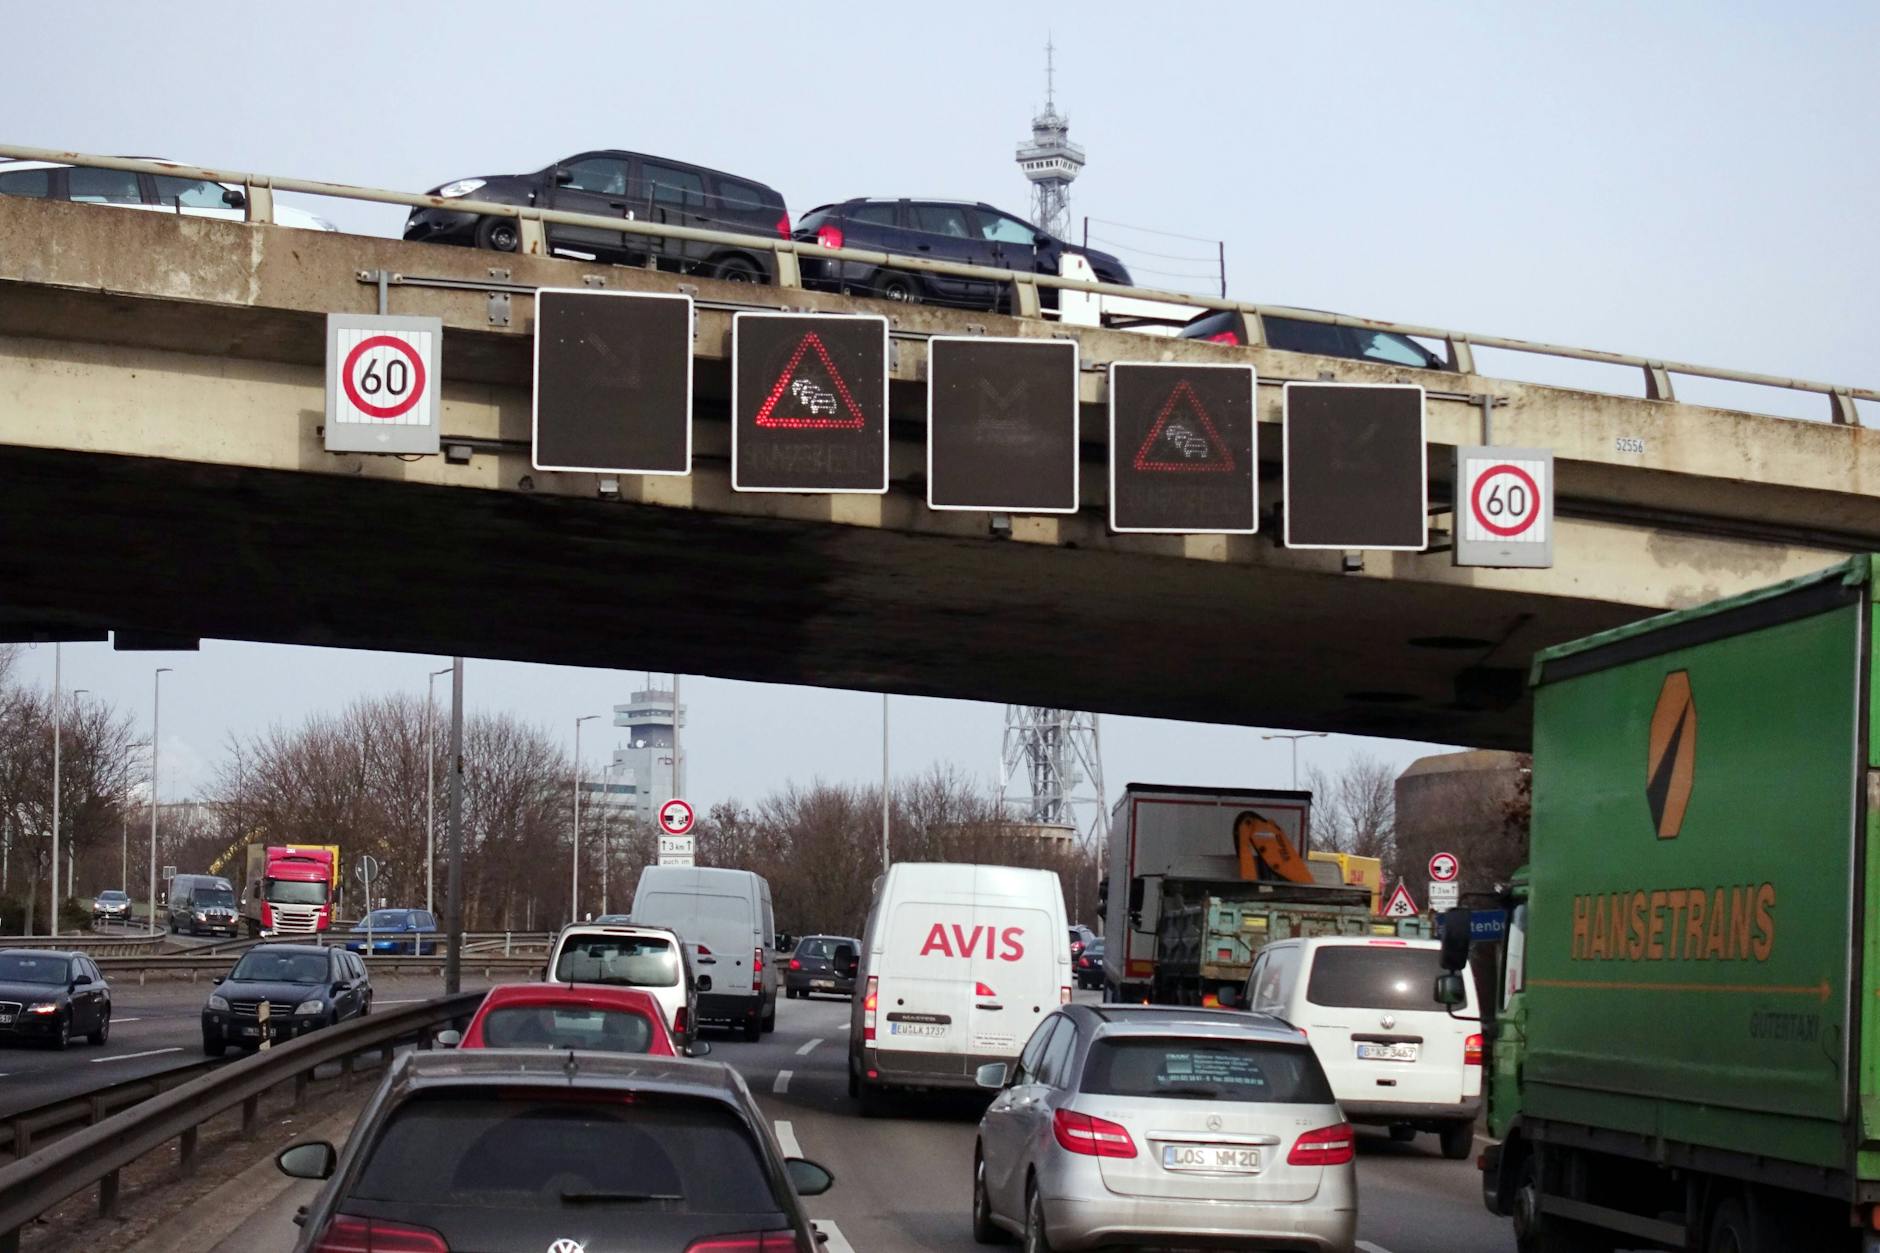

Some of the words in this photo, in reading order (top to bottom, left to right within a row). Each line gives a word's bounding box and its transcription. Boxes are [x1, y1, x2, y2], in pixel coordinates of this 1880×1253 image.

[361, 358, 407, 396] 60
[1616, 437, 1643, 453] 52556
[1487, 484, 1525, 516] 60
[668, 842, 674, 851] 3
[1572, 882, 1775, 961] HANSETRANS
[920, 923, 1024, 961] AVIS
[1174, 1147, 1205, 1164] LOS
[1239, 1151, 1258, 1167] 20
